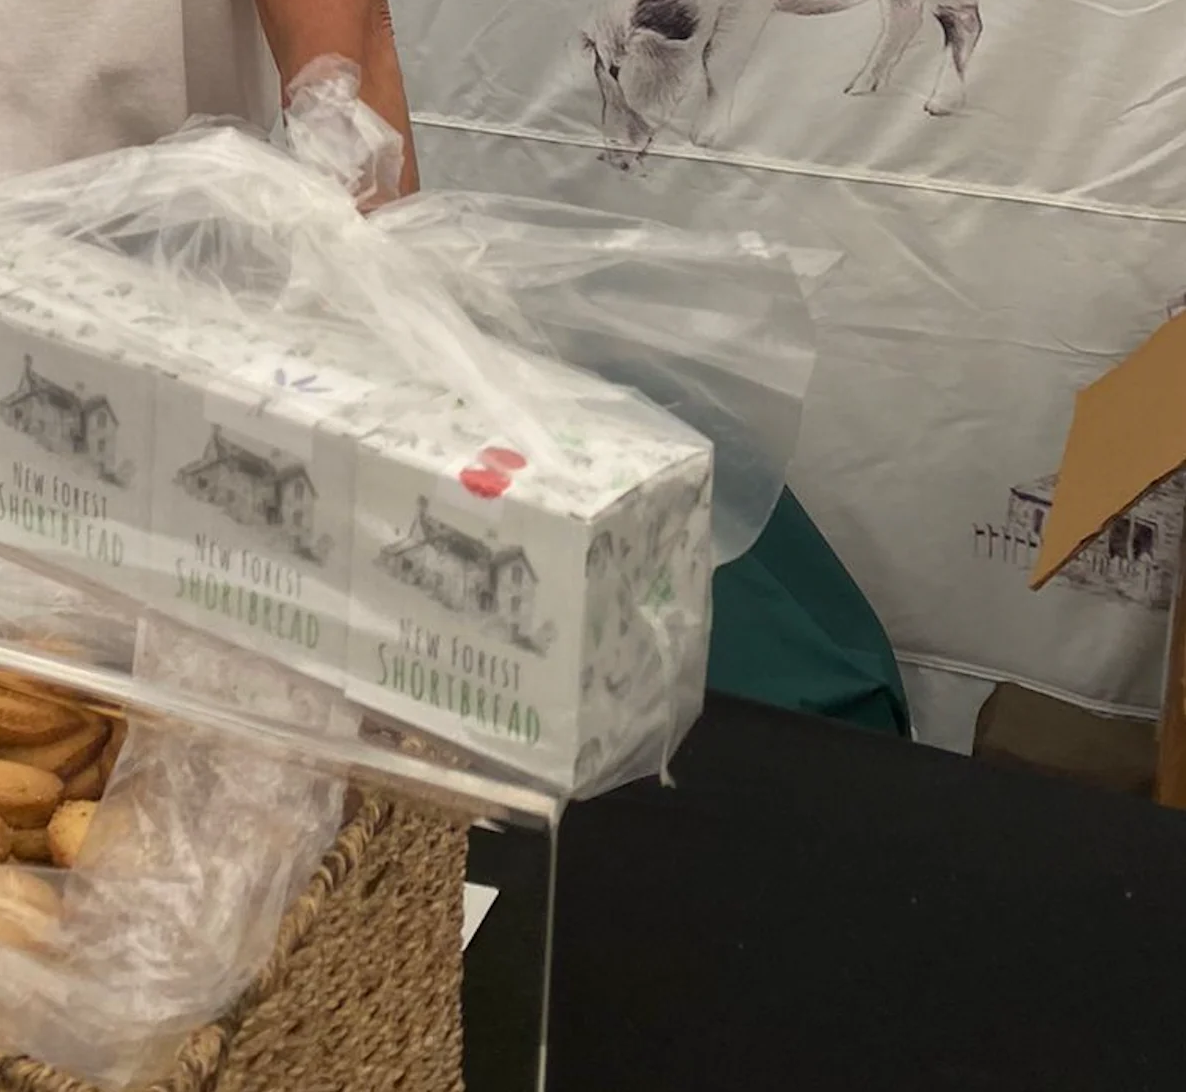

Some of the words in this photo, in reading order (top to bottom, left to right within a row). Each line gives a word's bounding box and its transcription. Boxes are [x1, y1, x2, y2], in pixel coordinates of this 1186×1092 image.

[14, 462, 43, 498] NEW
[53, 475, 107, 521] FOREST
[195, 532, 230, 572] NEW
[242, 550, 304, 601] FOREST
[175, 557, 321, 650] SHORTBREAD
[400, 619, 439, 659] NEW
[451, 637, 522, 691] FOREST
[376, 642, 542, 746] SHORTBREAD
